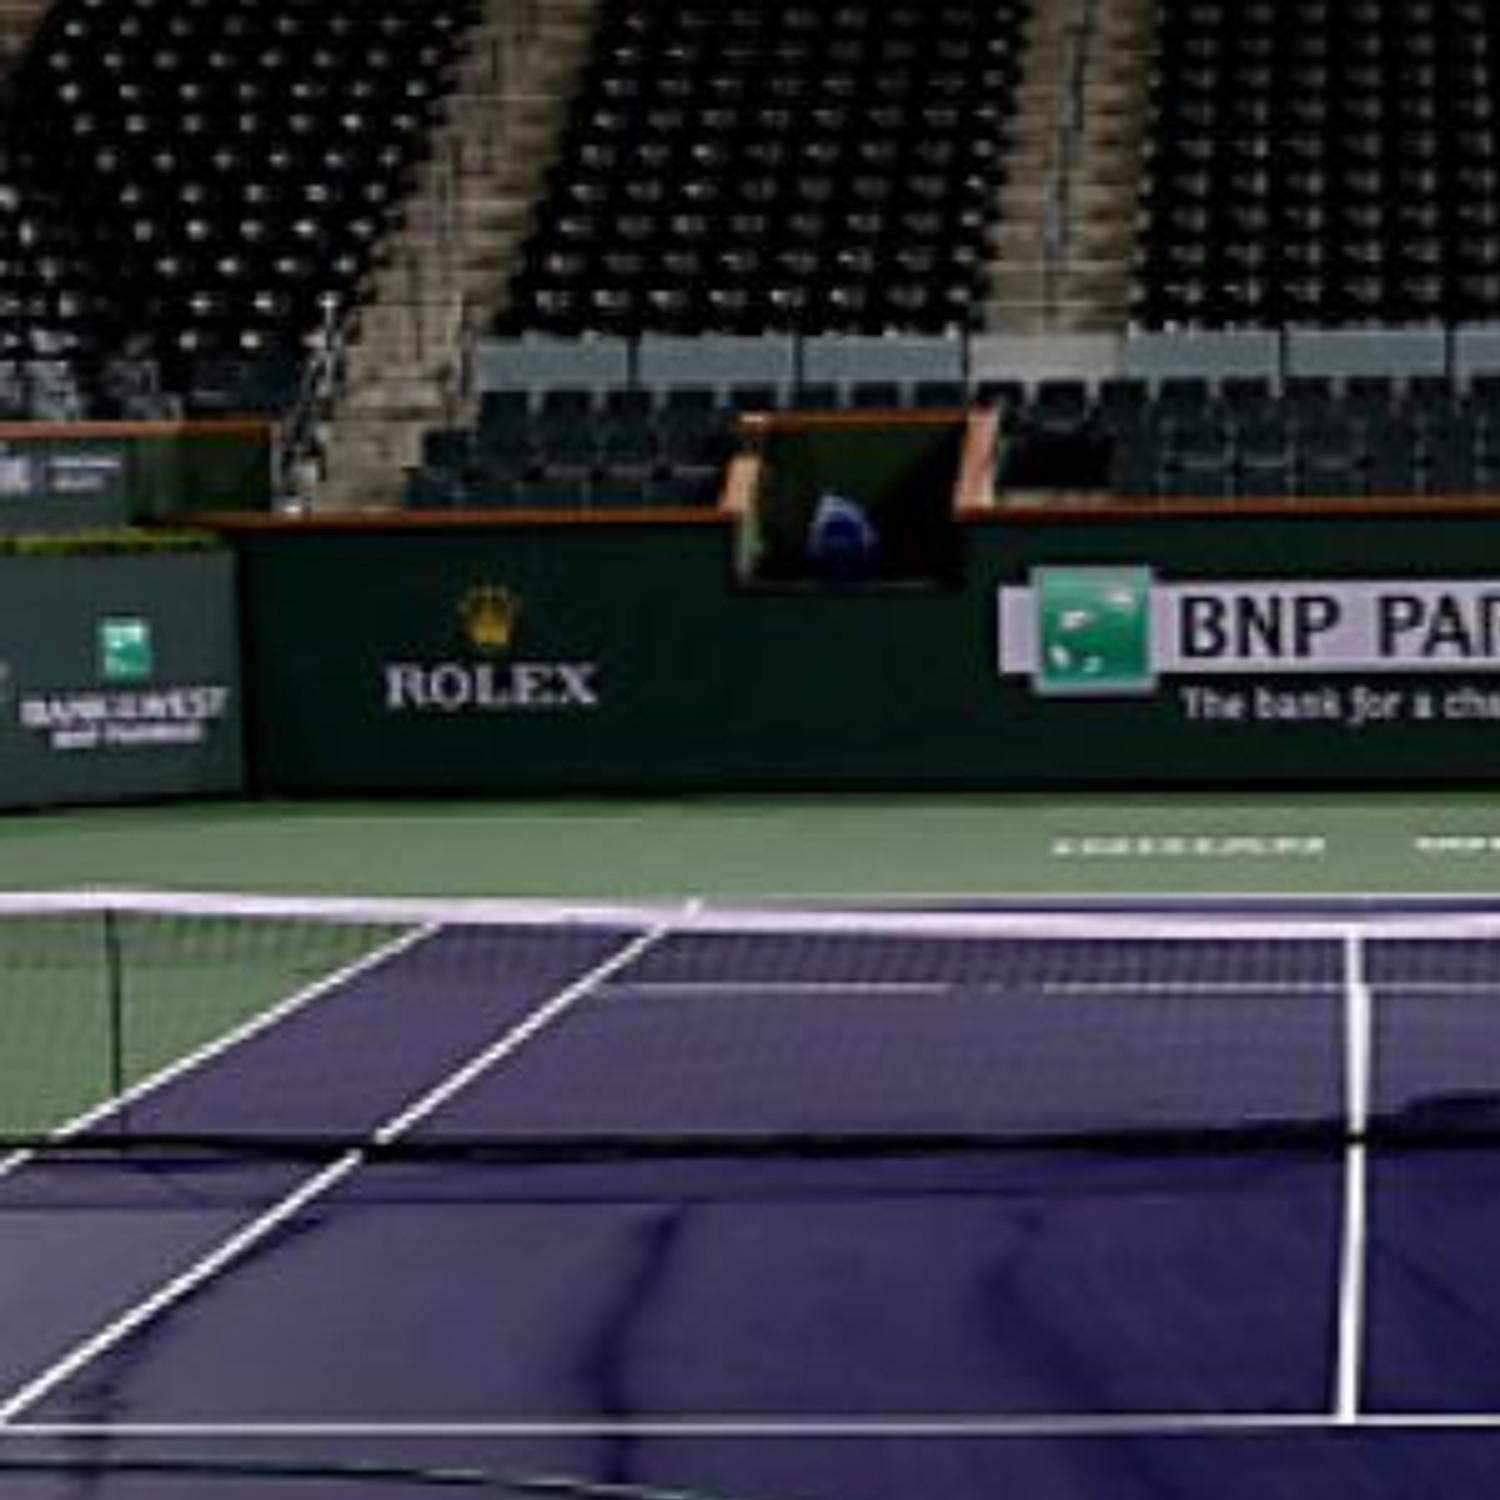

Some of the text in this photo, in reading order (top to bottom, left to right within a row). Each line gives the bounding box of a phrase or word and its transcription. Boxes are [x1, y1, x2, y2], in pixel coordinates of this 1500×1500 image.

[1178, 594, 1343, 658] BNP
[385, 662, 600, 709] ROLEX
[1183, 686, 1246, 719] The
[1255, 686, 1342, 719] bank
[1346, 686, 1402, 724] for
[1412, 692, 1435, 719] a
